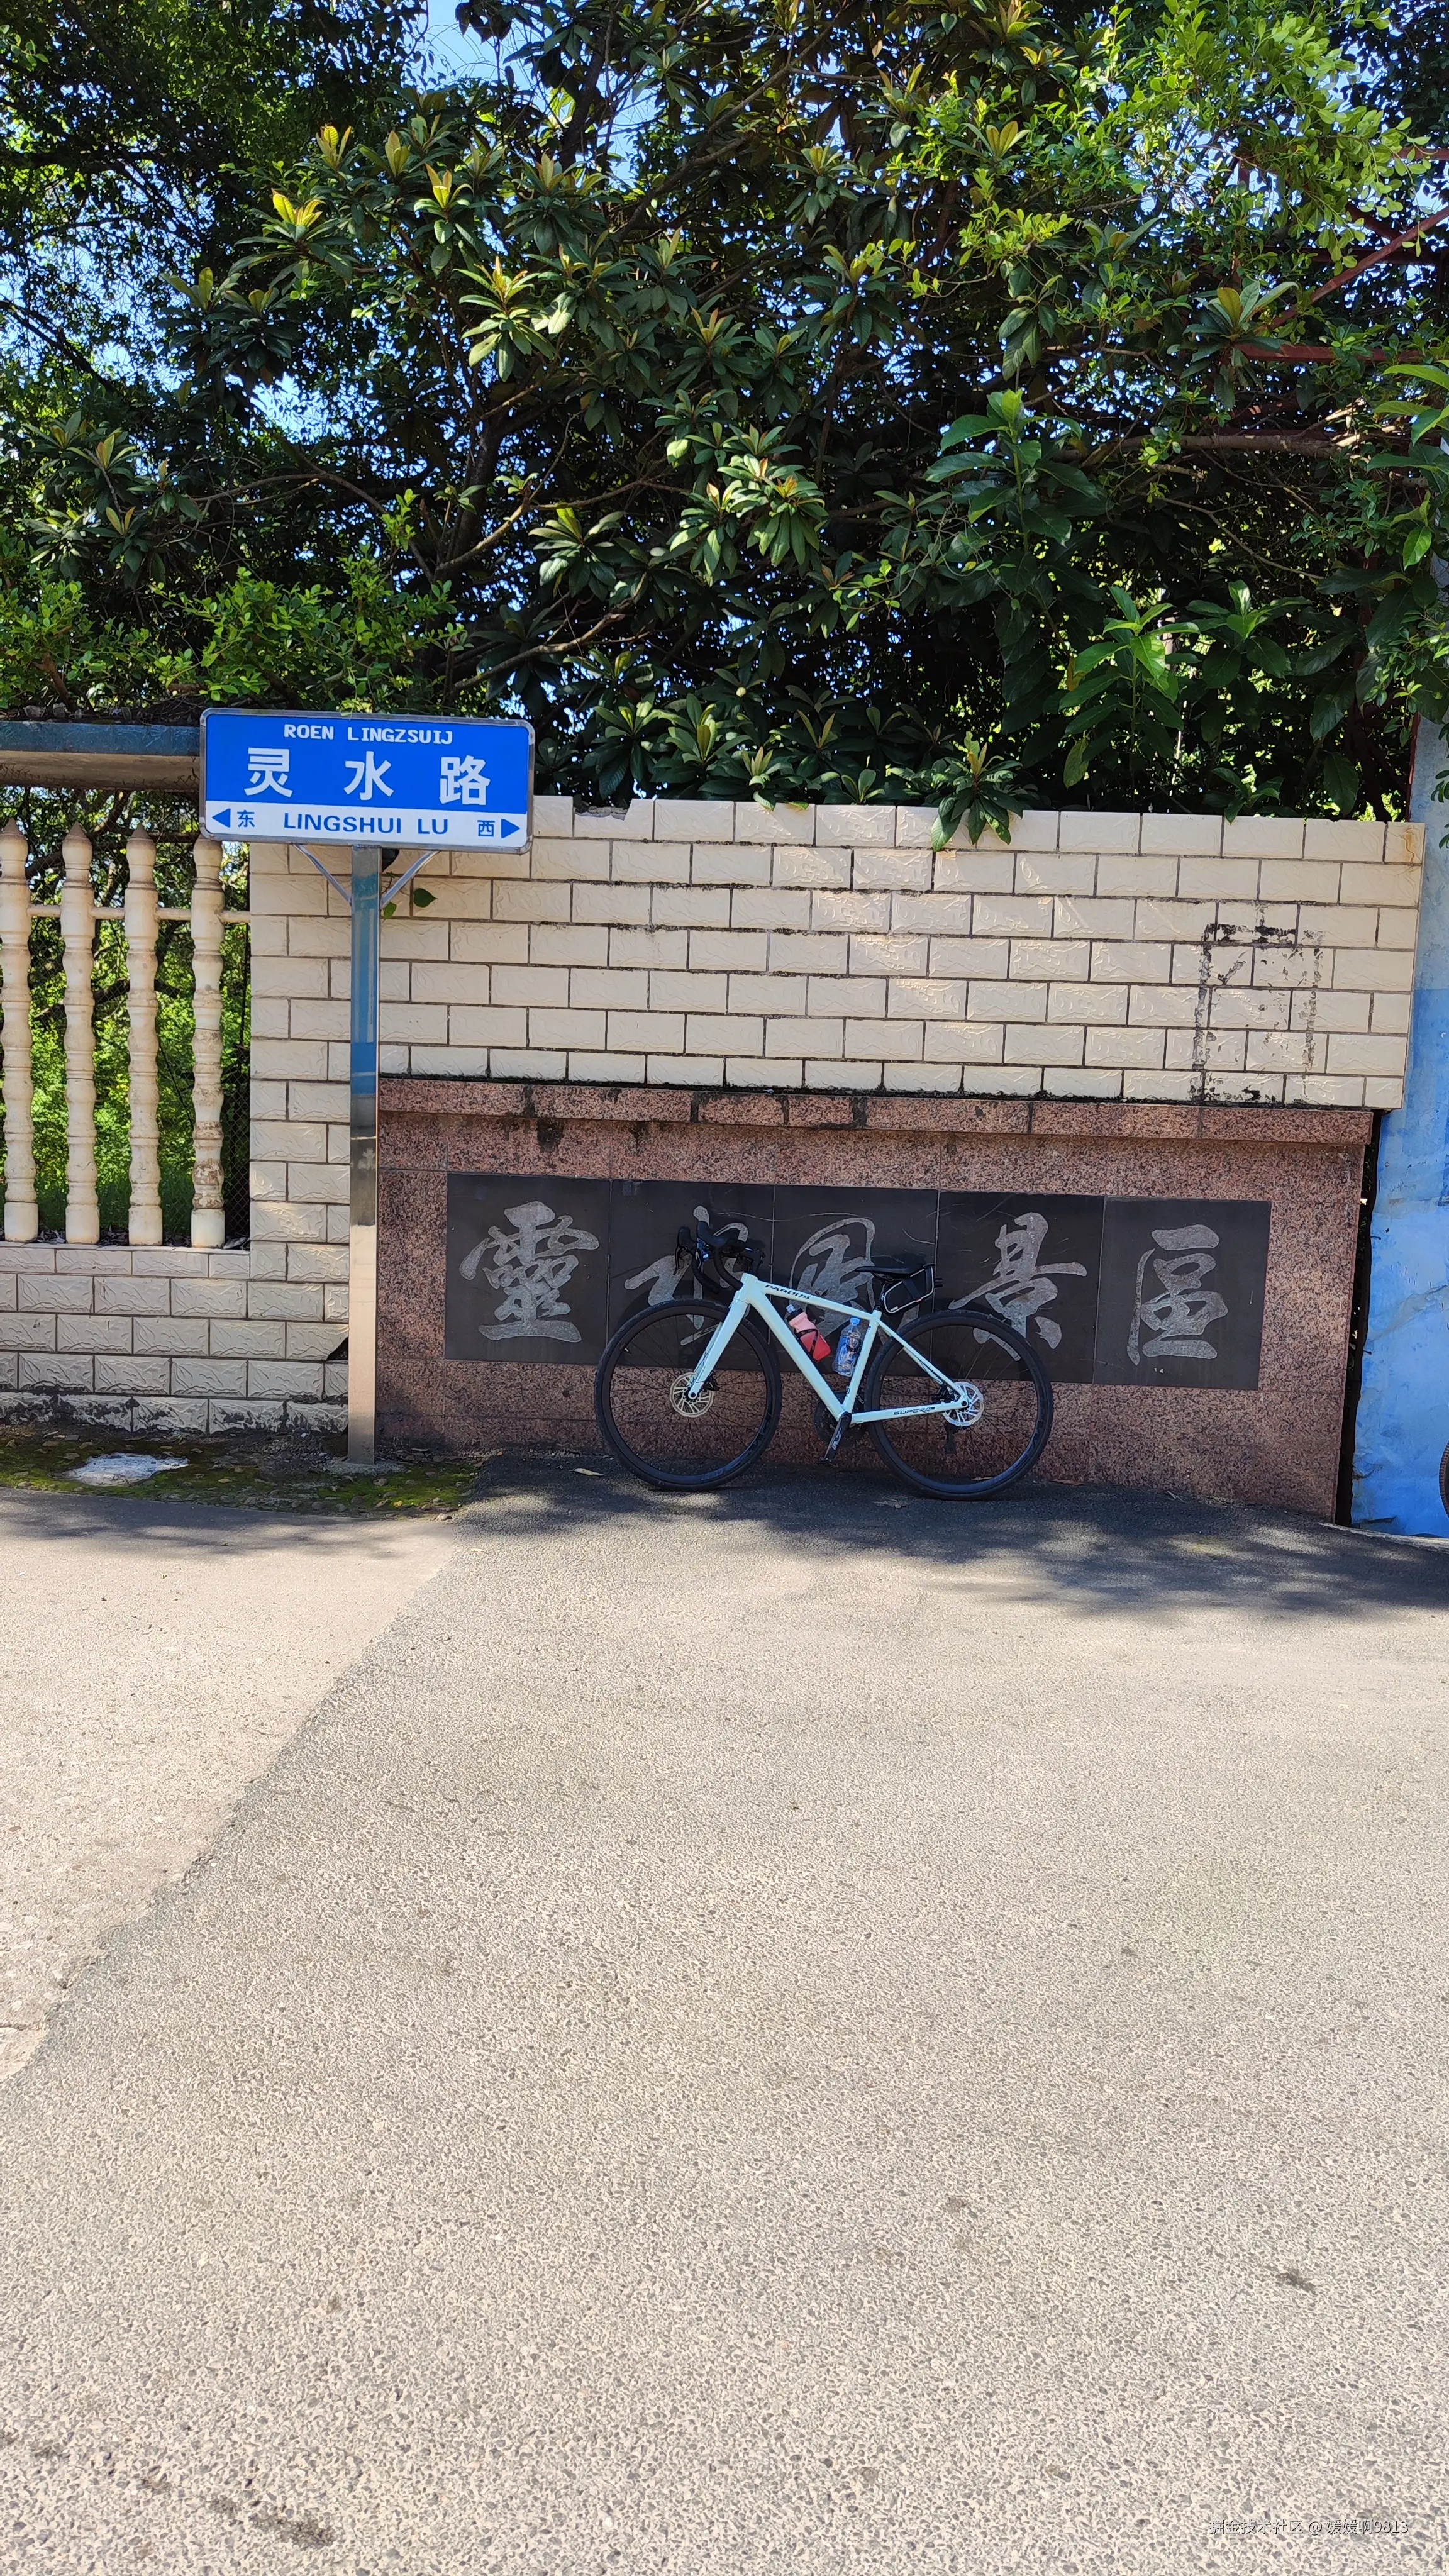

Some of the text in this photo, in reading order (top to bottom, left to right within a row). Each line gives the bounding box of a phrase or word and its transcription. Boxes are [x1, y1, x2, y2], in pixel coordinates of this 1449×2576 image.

[284, 724, 453, 745] ROEN LINGZSUIJ
[243, 747, 491, 806] 灵水路
[236, 809, 255, 828] 东
[284, 812, 448, 835] LINGSHUI LU
[477, 819, 495, 837] 西
